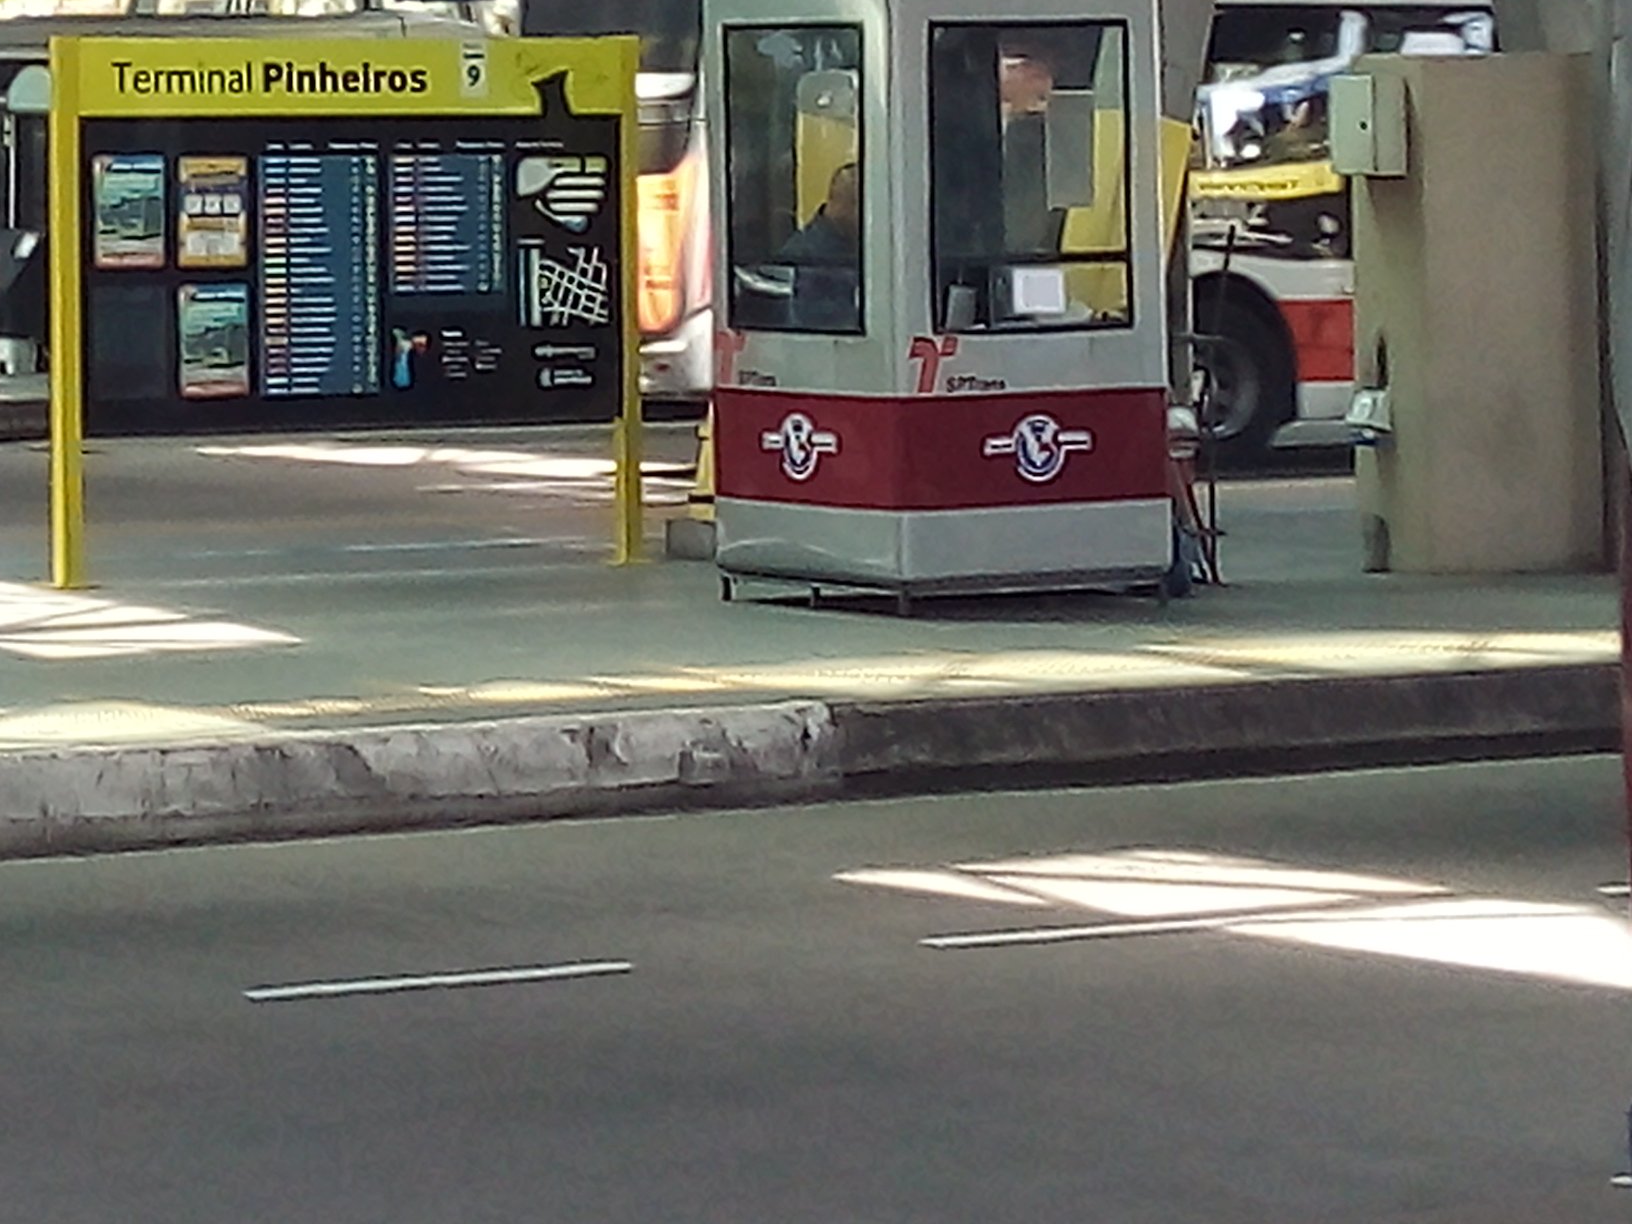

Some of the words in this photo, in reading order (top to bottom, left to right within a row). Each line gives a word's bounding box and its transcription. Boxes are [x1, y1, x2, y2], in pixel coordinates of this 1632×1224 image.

[111, 62, 252, 93] Terminal
[262, 62, 428, 93] Pinheiros
[467, 65, 480, 87] 9
